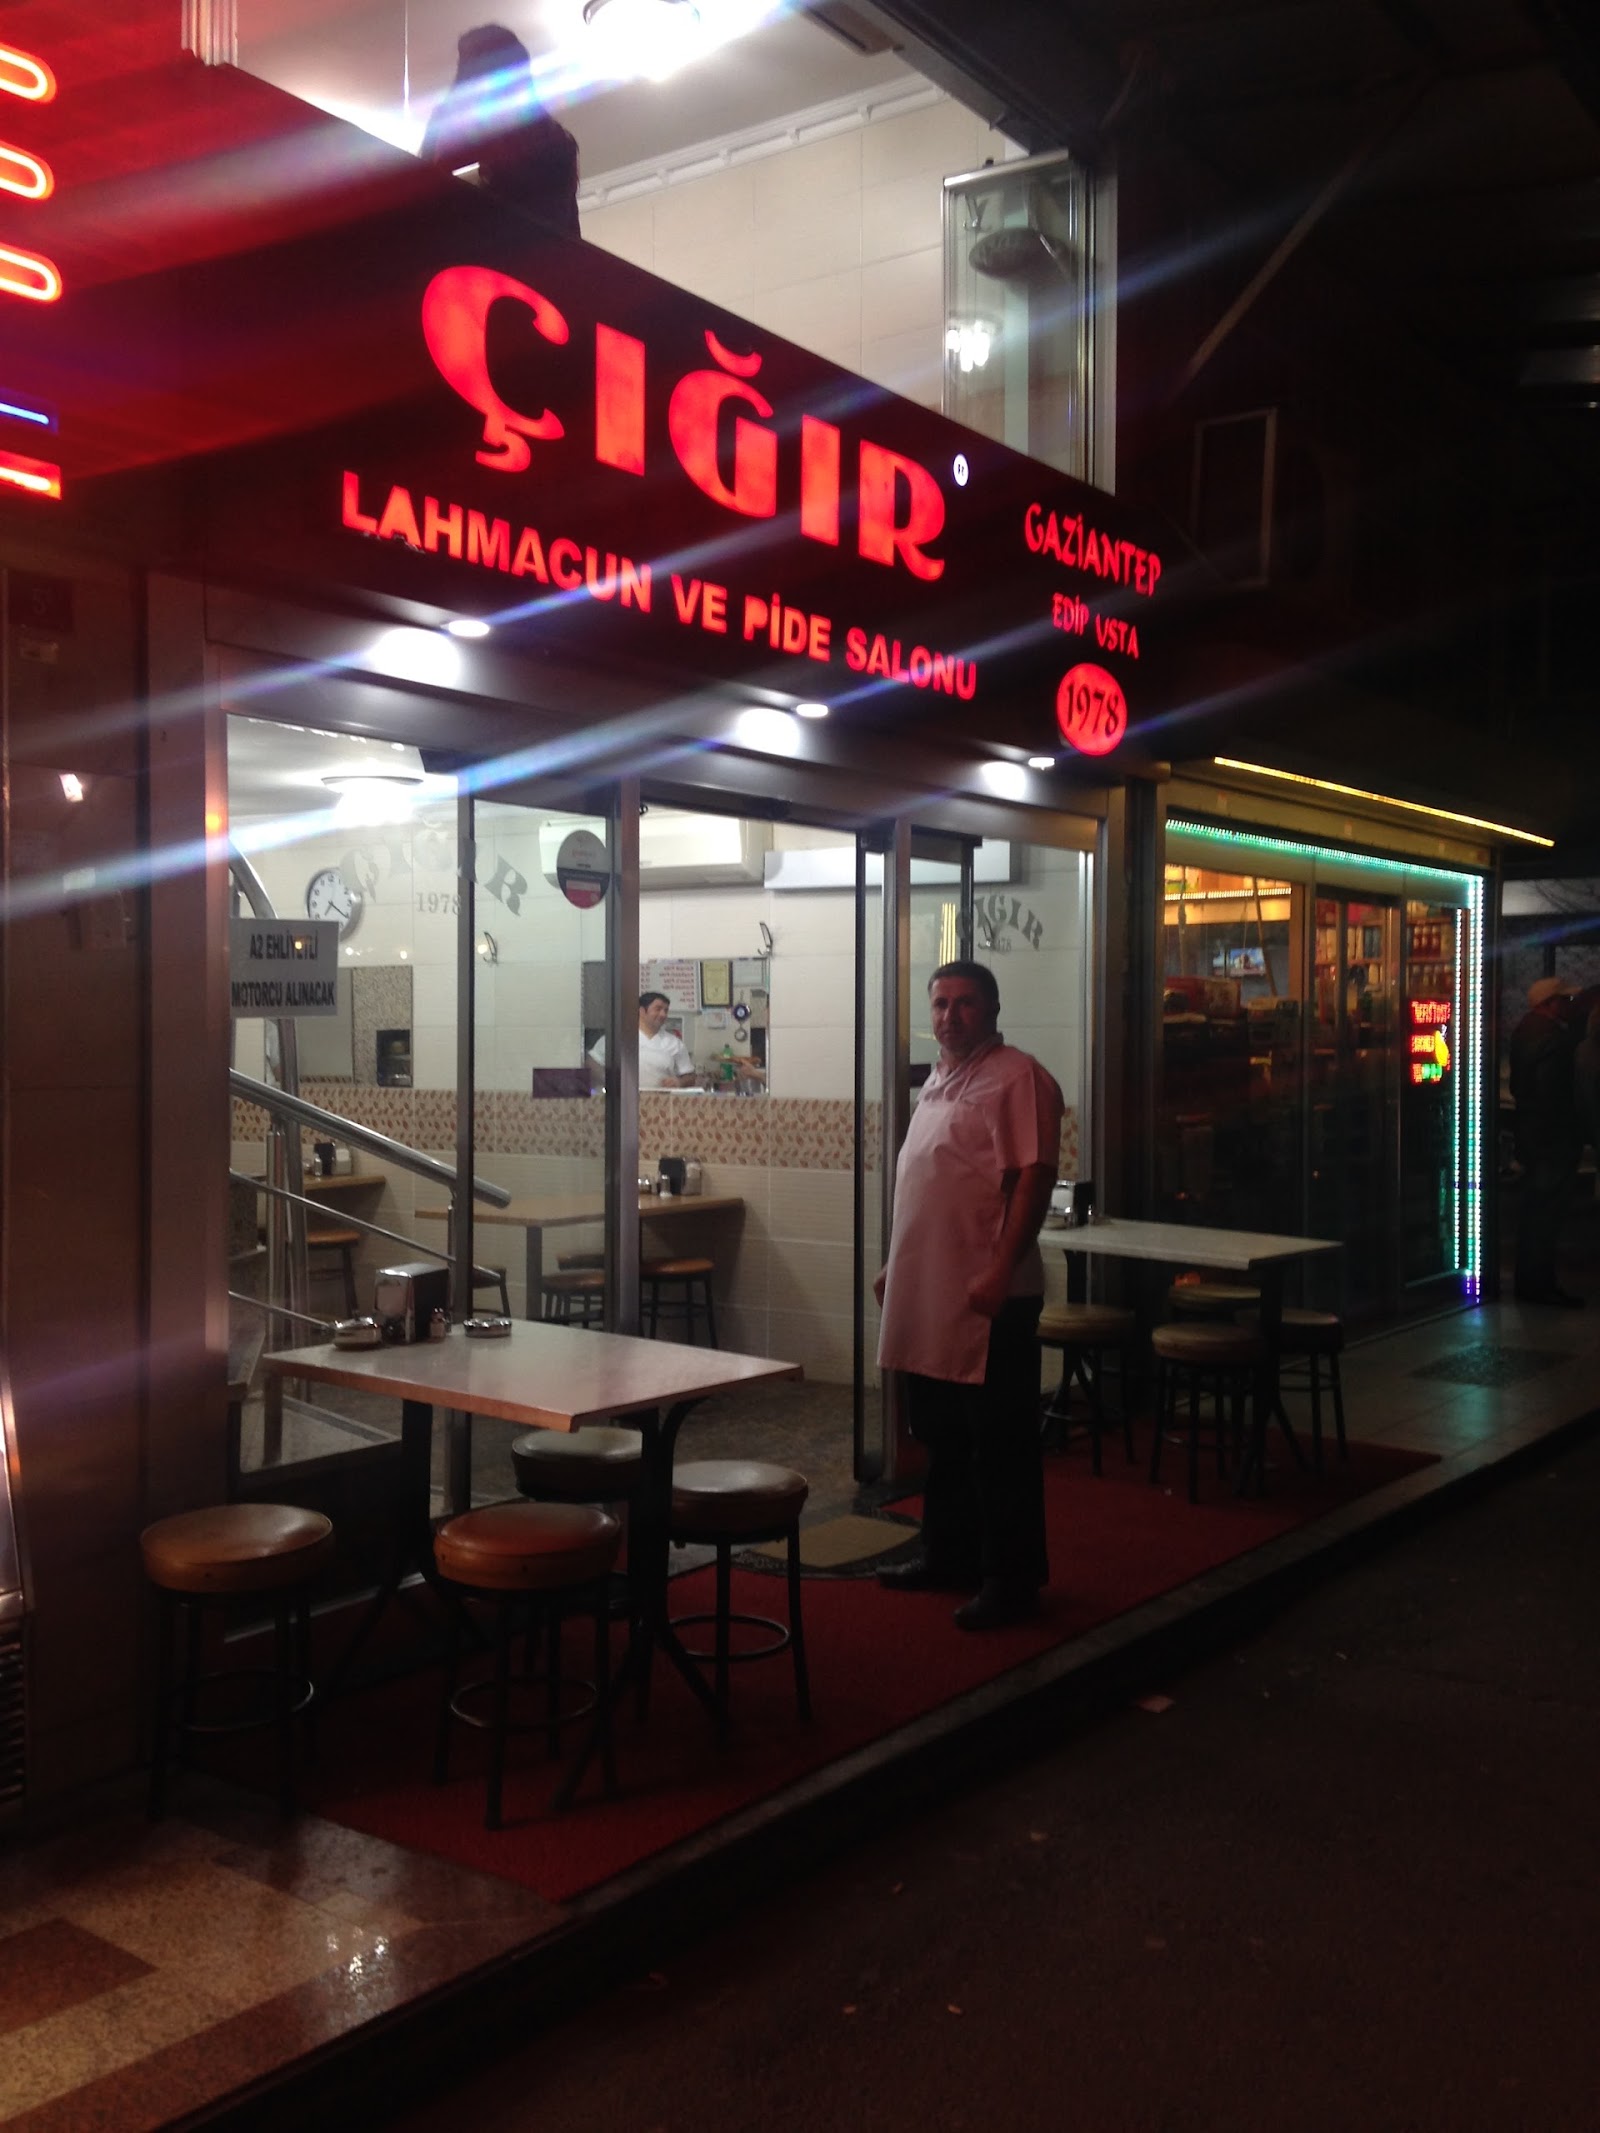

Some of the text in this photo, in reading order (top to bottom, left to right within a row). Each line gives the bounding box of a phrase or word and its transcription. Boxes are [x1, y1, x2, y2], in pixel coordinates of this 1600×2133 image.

[421, 264, 946, 582] ÇIĞIR
[1024, 501, 1162, 598] GAZİANTEP
[342, 470, 978, 700] LAHMACUN VE PİDE SALONU
[1052, 591, 1140, 660] EDİP USTA
[1067, 681, 1120, 737] 1978
[415, 891, 463, 917] 1978
[249, 933, 264, 960] A2
[231, 981, 336, 1008] MOTORCU ALINACAK
